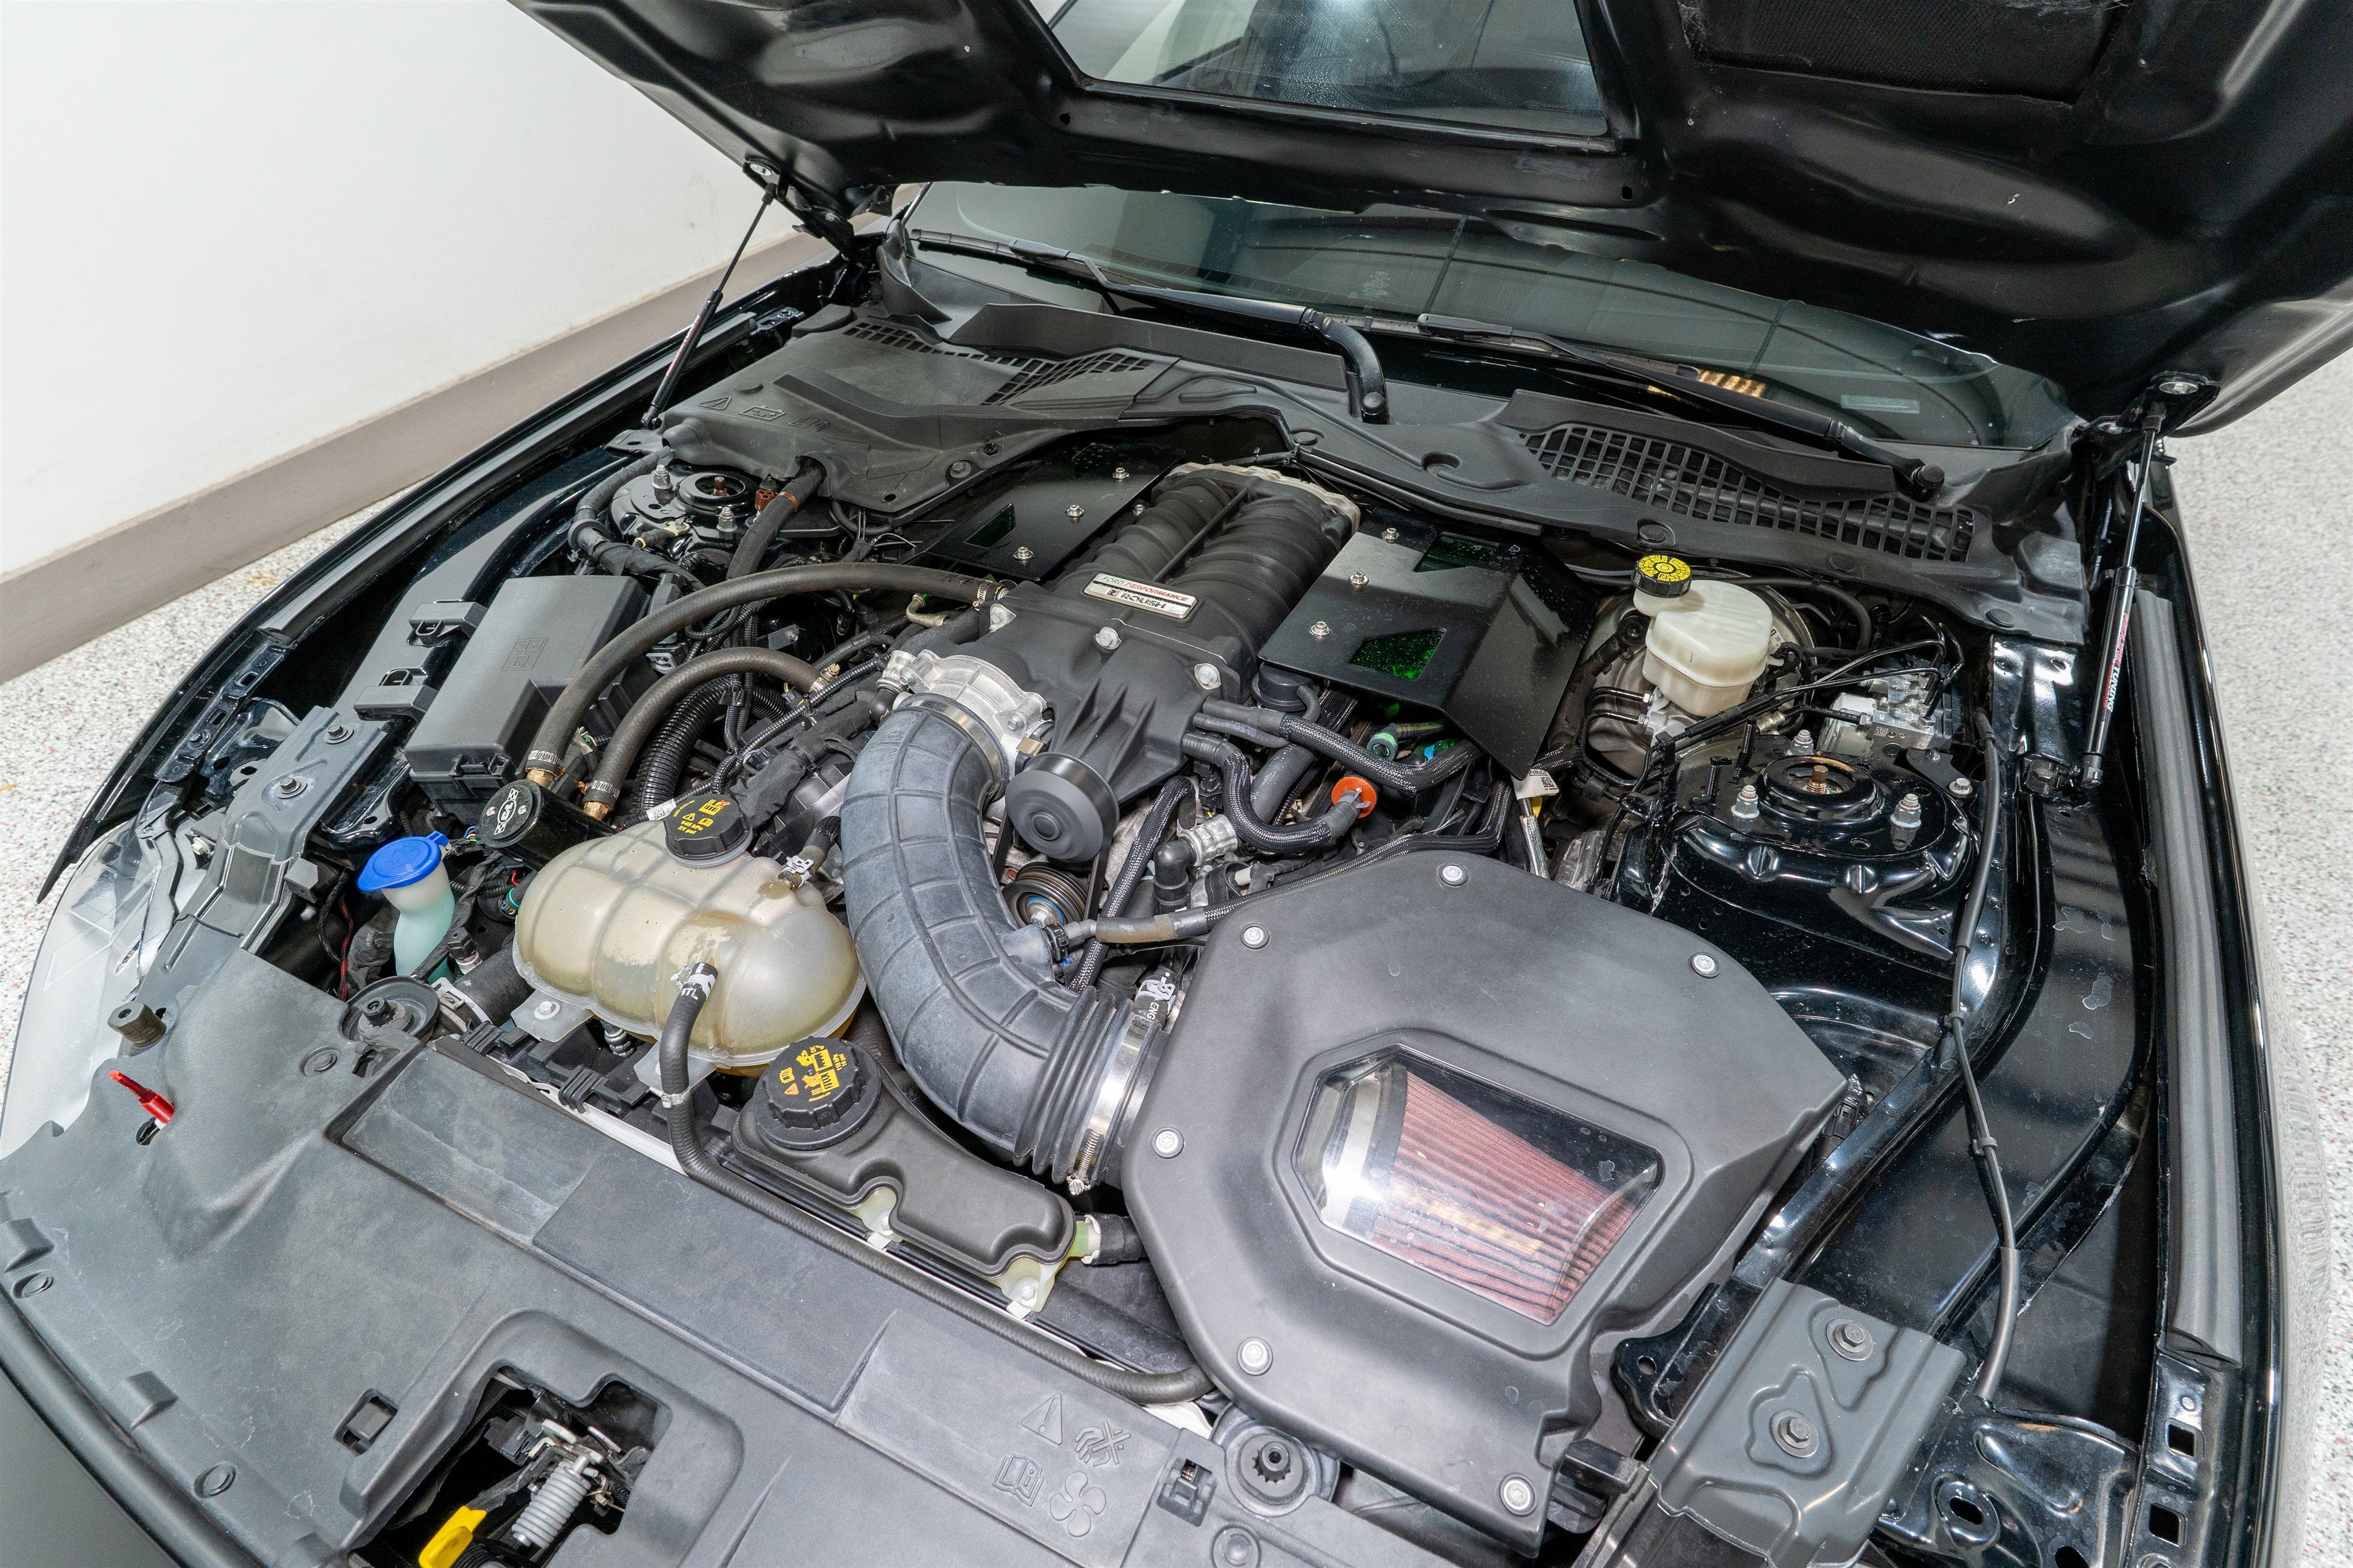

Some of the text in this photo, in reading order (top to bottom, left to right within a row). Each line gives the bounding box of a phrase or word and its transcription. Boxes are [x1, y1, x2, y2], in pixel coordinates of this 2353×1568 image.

[1102, 576, 1189, 602] FORD PERFORMANCE
[1121, 593, 1167, 609] ROUSH
[2107, 666, 2121, 712] TUNING
[1147, 1001, 1159, 1020] ENG
